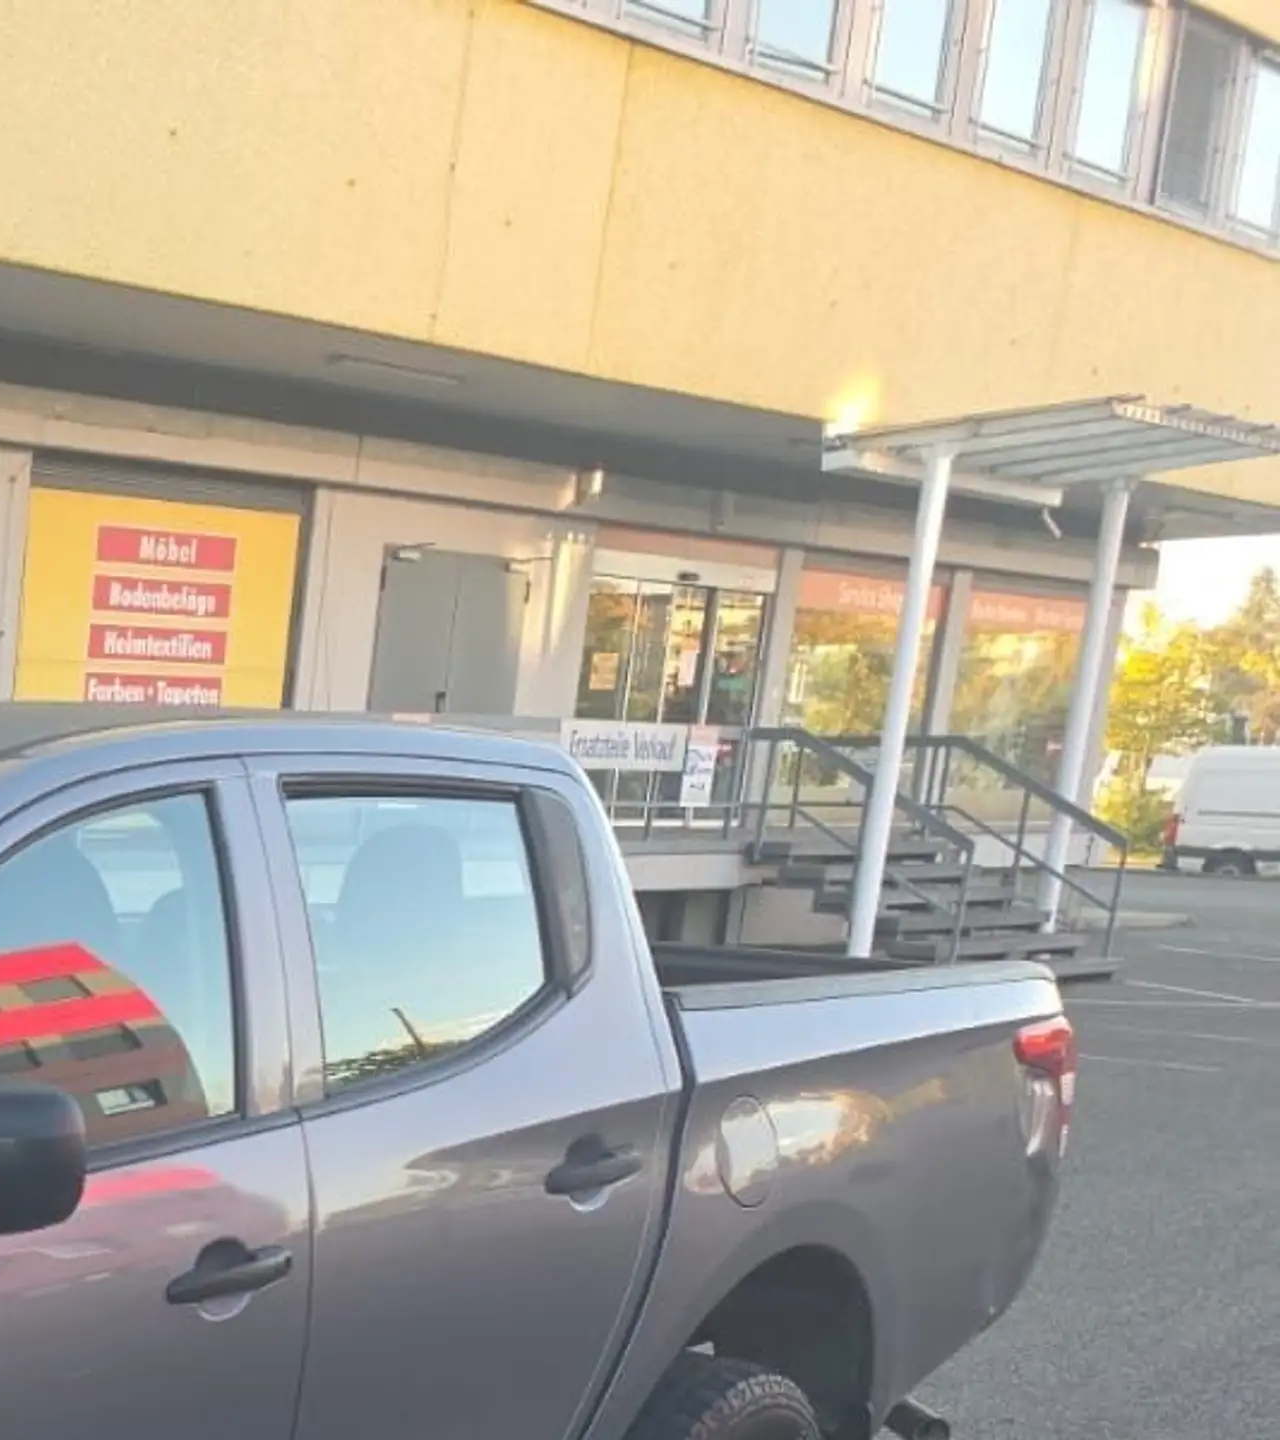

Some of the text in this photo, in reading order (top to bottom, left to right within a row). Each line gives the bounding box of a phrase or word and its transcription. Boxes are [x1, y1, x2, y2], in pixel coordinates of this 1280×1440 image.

[139, 534, 197, 564] Möbel
[109, 580, 216, 615] Bodenbeläge
[103, 629, 213, 659] Heimtextilien
[88, 677, 219, 706] Farben Tapeten
